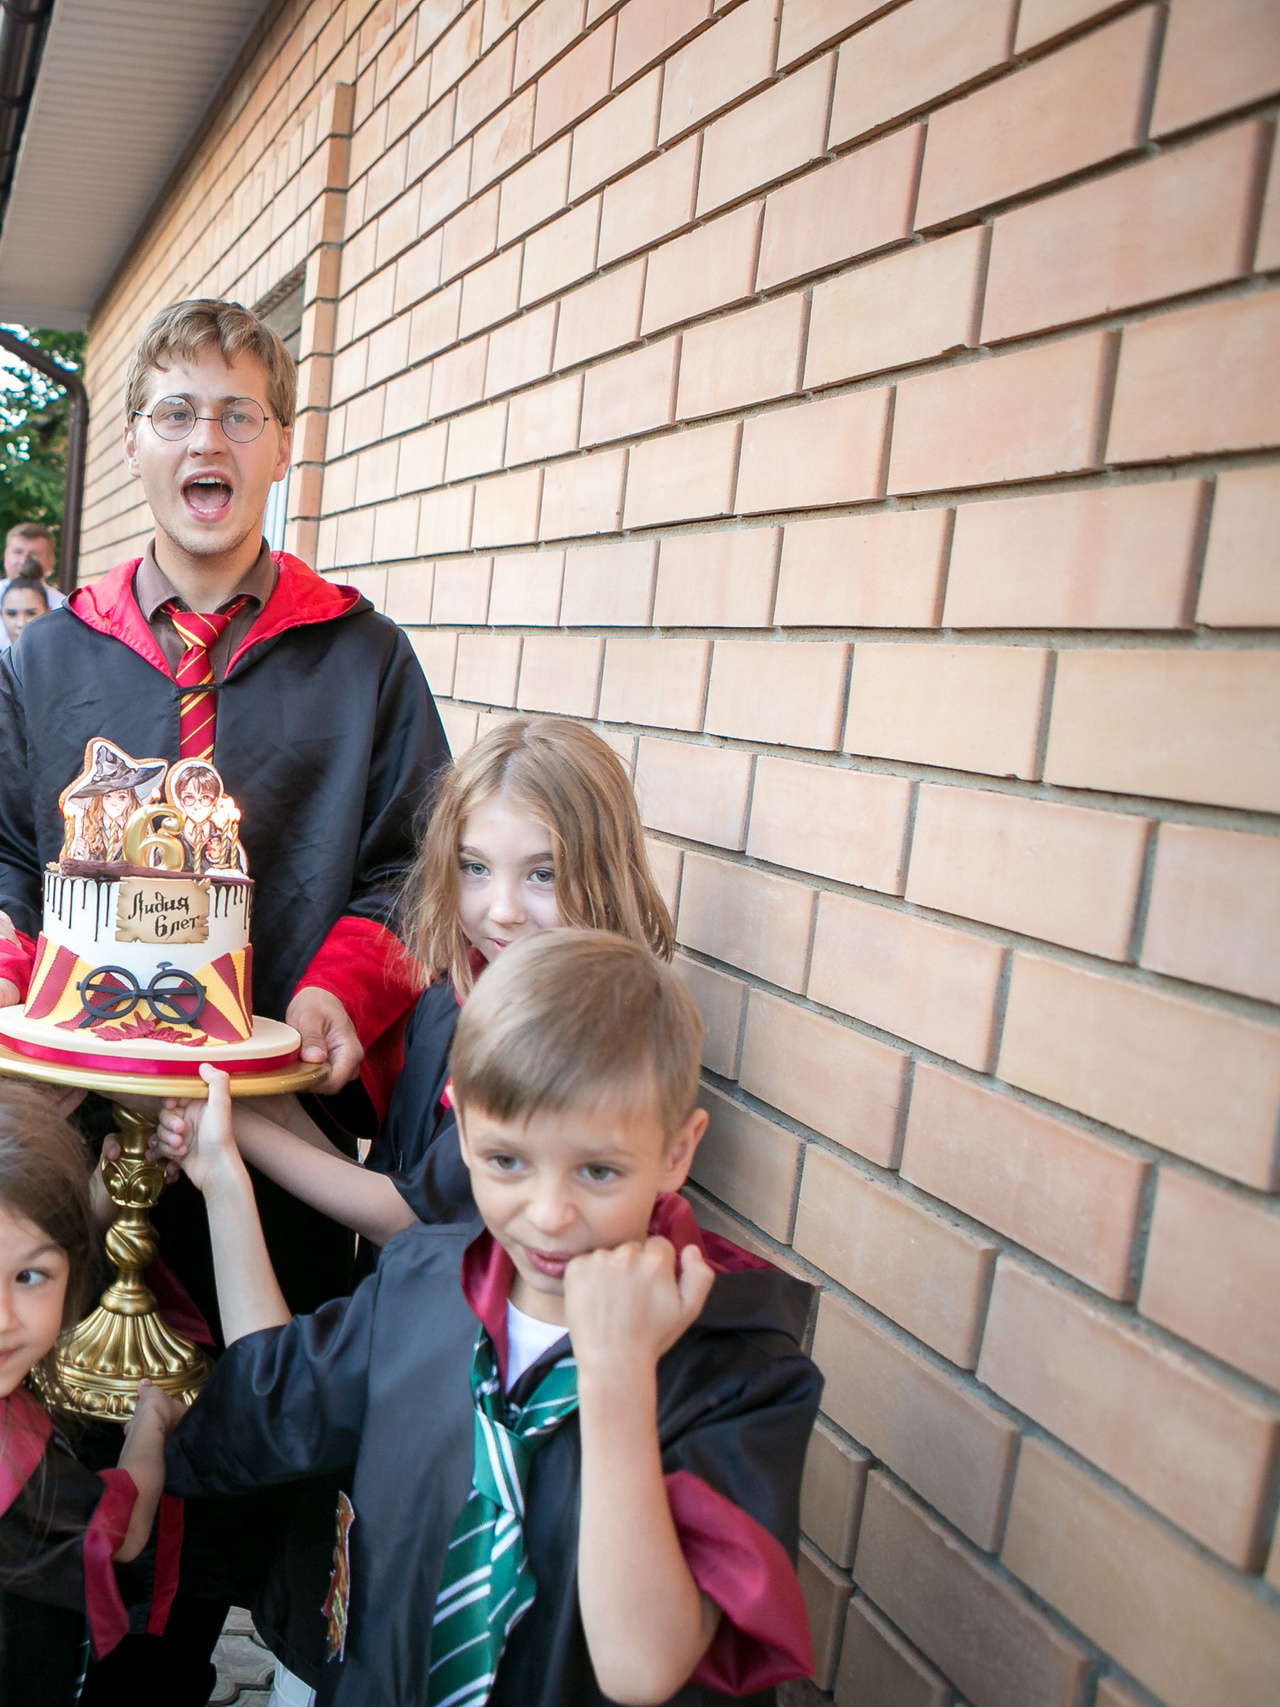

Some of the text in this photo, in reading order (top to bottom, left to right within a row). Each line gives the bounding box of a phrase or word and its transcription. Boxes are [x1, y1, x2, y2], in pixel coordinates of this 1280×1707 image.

[122, 803, 185, 873] 6
[127, 890, 190, 922] Лидия
[166, 915, 200, 940] лет
